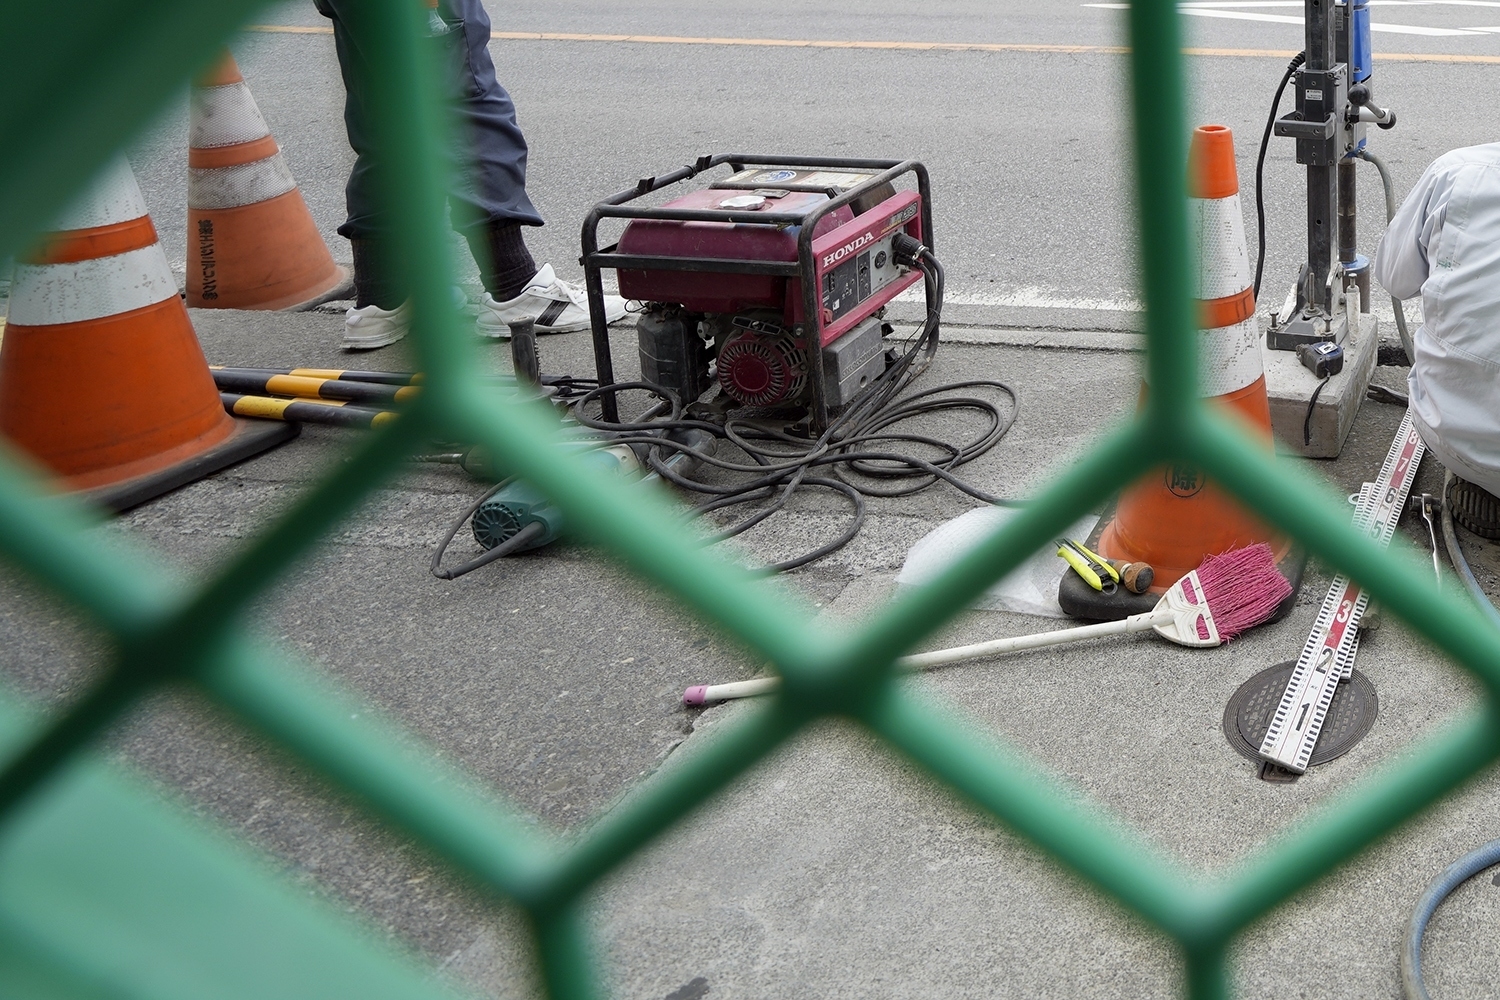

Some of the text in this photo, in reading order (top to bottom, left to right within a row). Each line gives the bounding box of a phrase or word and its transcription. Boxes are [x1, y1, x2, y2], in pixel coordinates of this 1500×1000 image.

[823, 231, 874, 268] HONDA
[1408, 429, 1418, 445] 8
[1398, 457, 1409, 472] 7
[1384, 487, 1397, 504] 6
[1371, 520, 1384, 540] 5
[1336, 599, 1352, 623] 3
[1315, 647, 1333, 675] 2
[1295, 702, 1311, 732] 1
